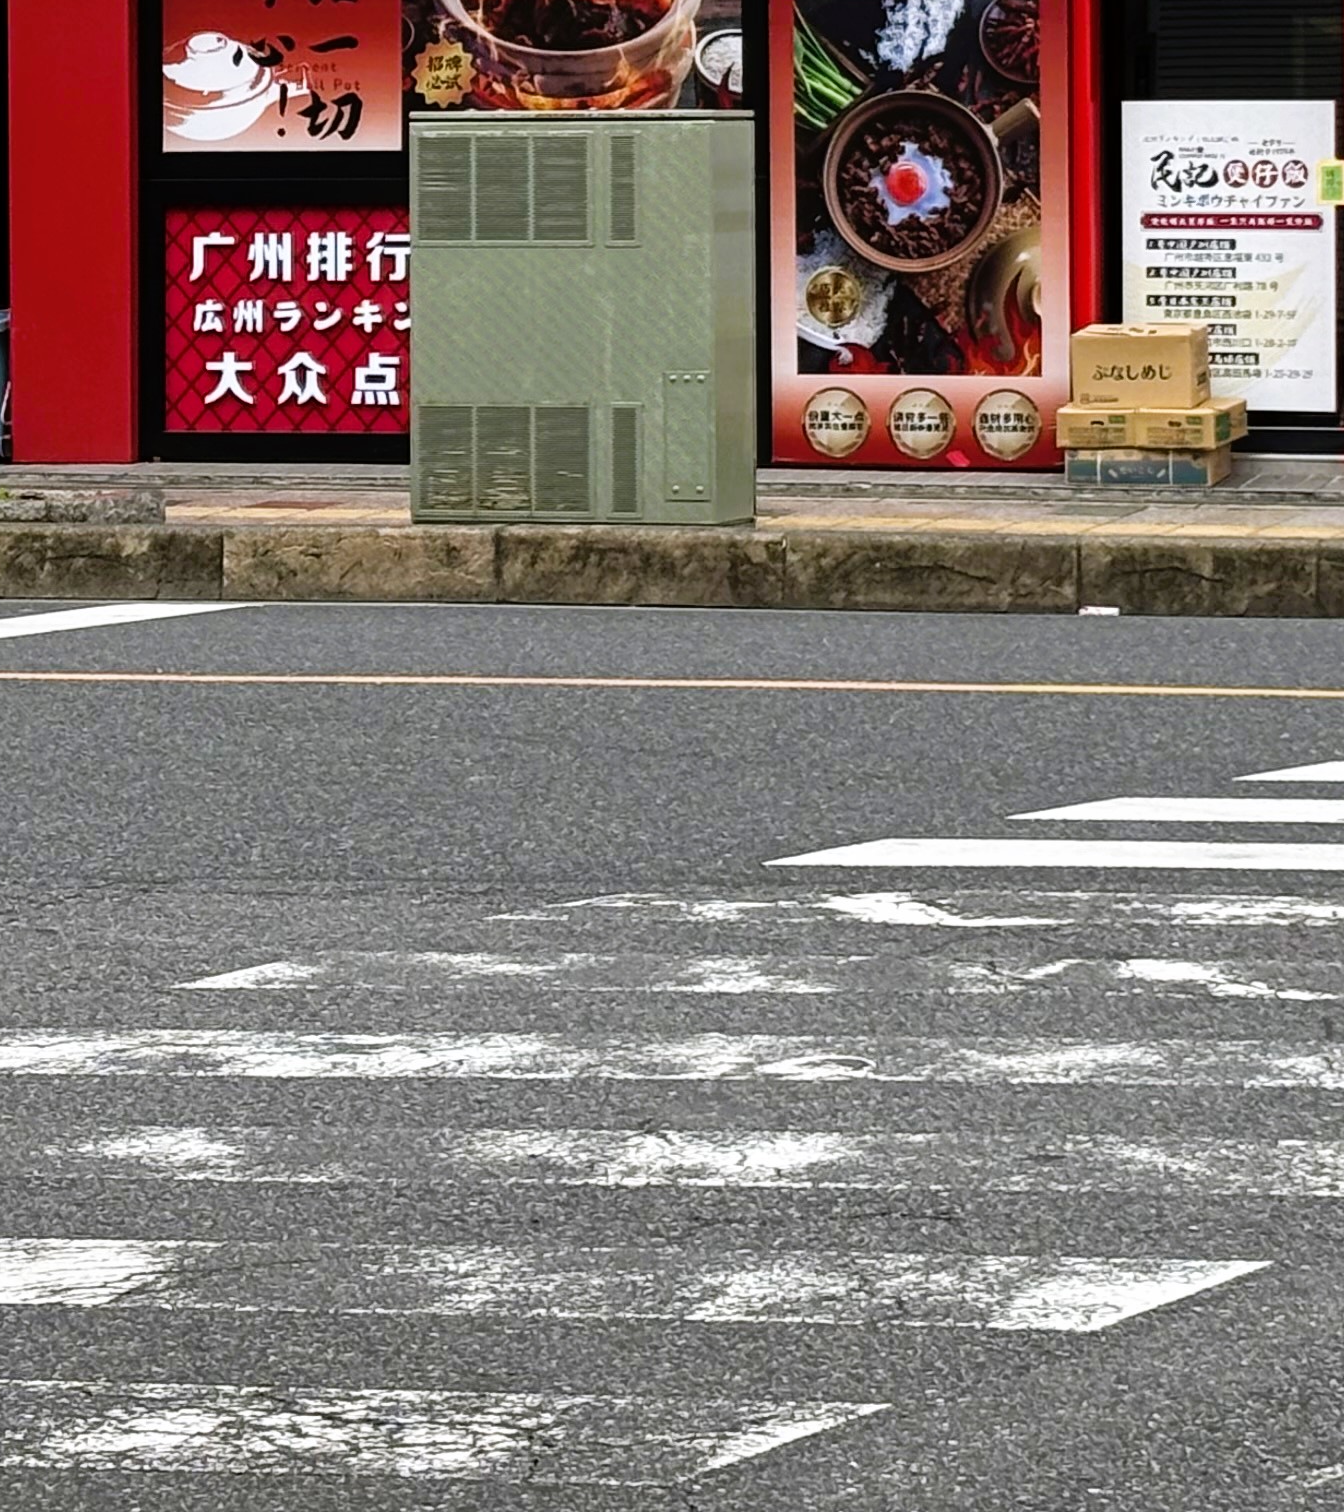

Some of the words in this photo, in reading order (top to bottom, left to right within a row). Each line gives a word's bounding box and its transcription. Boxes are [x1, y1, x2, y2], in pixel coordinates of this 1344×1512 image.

[189, 232, 410, 282] 广州排行
[204, 352, 401, 406] 大众点
[1092, 364, 1173, 381] ぶなしめじ
